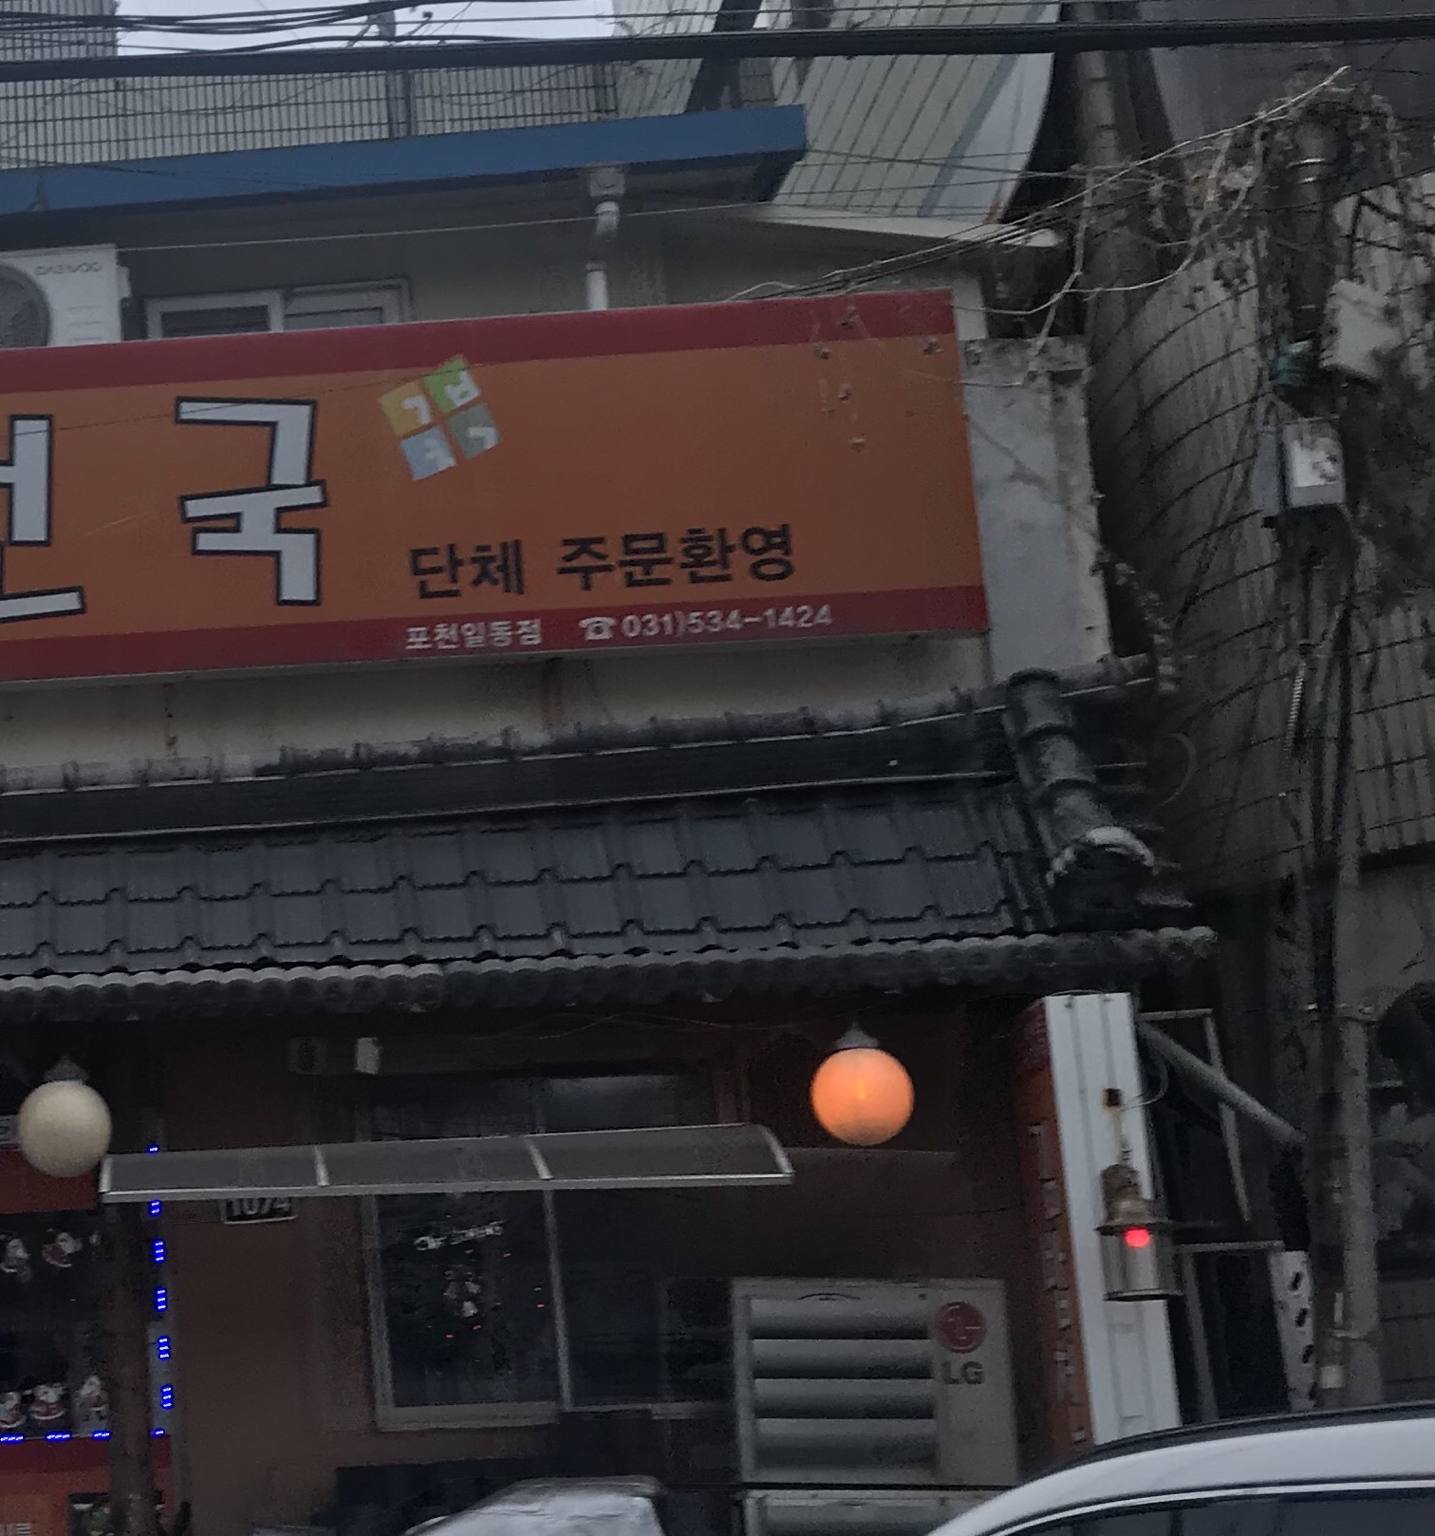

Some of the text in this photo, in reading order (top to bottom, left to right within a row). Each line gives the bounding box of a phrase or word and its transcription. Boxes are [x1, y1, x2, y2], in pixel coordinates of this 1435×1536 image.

[408, 523, 796, 599] 단체 주문환영
[405, 604, 834, 651] 포천일동점 031)534-1424
[942, 1360, 985, 1385] LG
